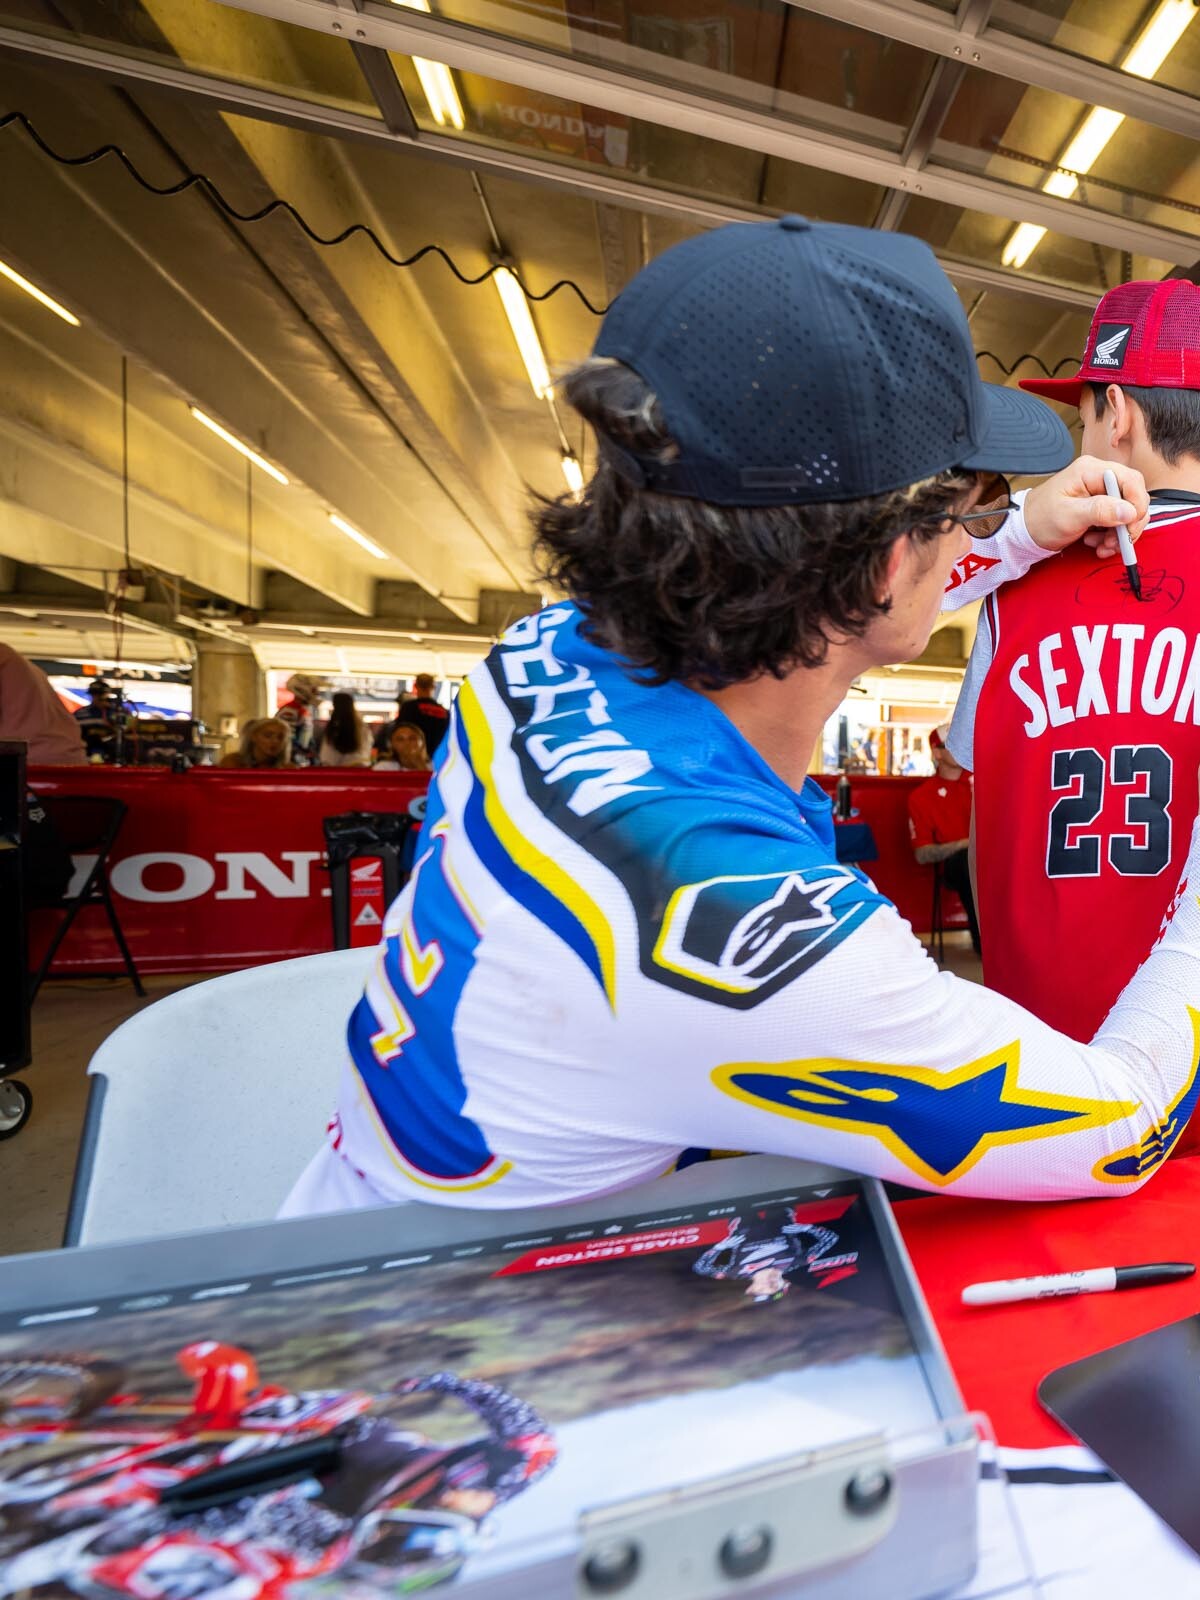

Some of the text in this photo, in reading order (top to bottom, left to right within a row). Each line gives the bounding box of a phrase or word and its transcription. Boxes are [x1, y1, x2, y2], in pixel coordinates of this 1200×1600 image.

[1093, 357, 1120, 366] HONDA
[1046, 743, 1173, 878] 23
[535, 1234, 700, 1267] CHASE SEXTON
